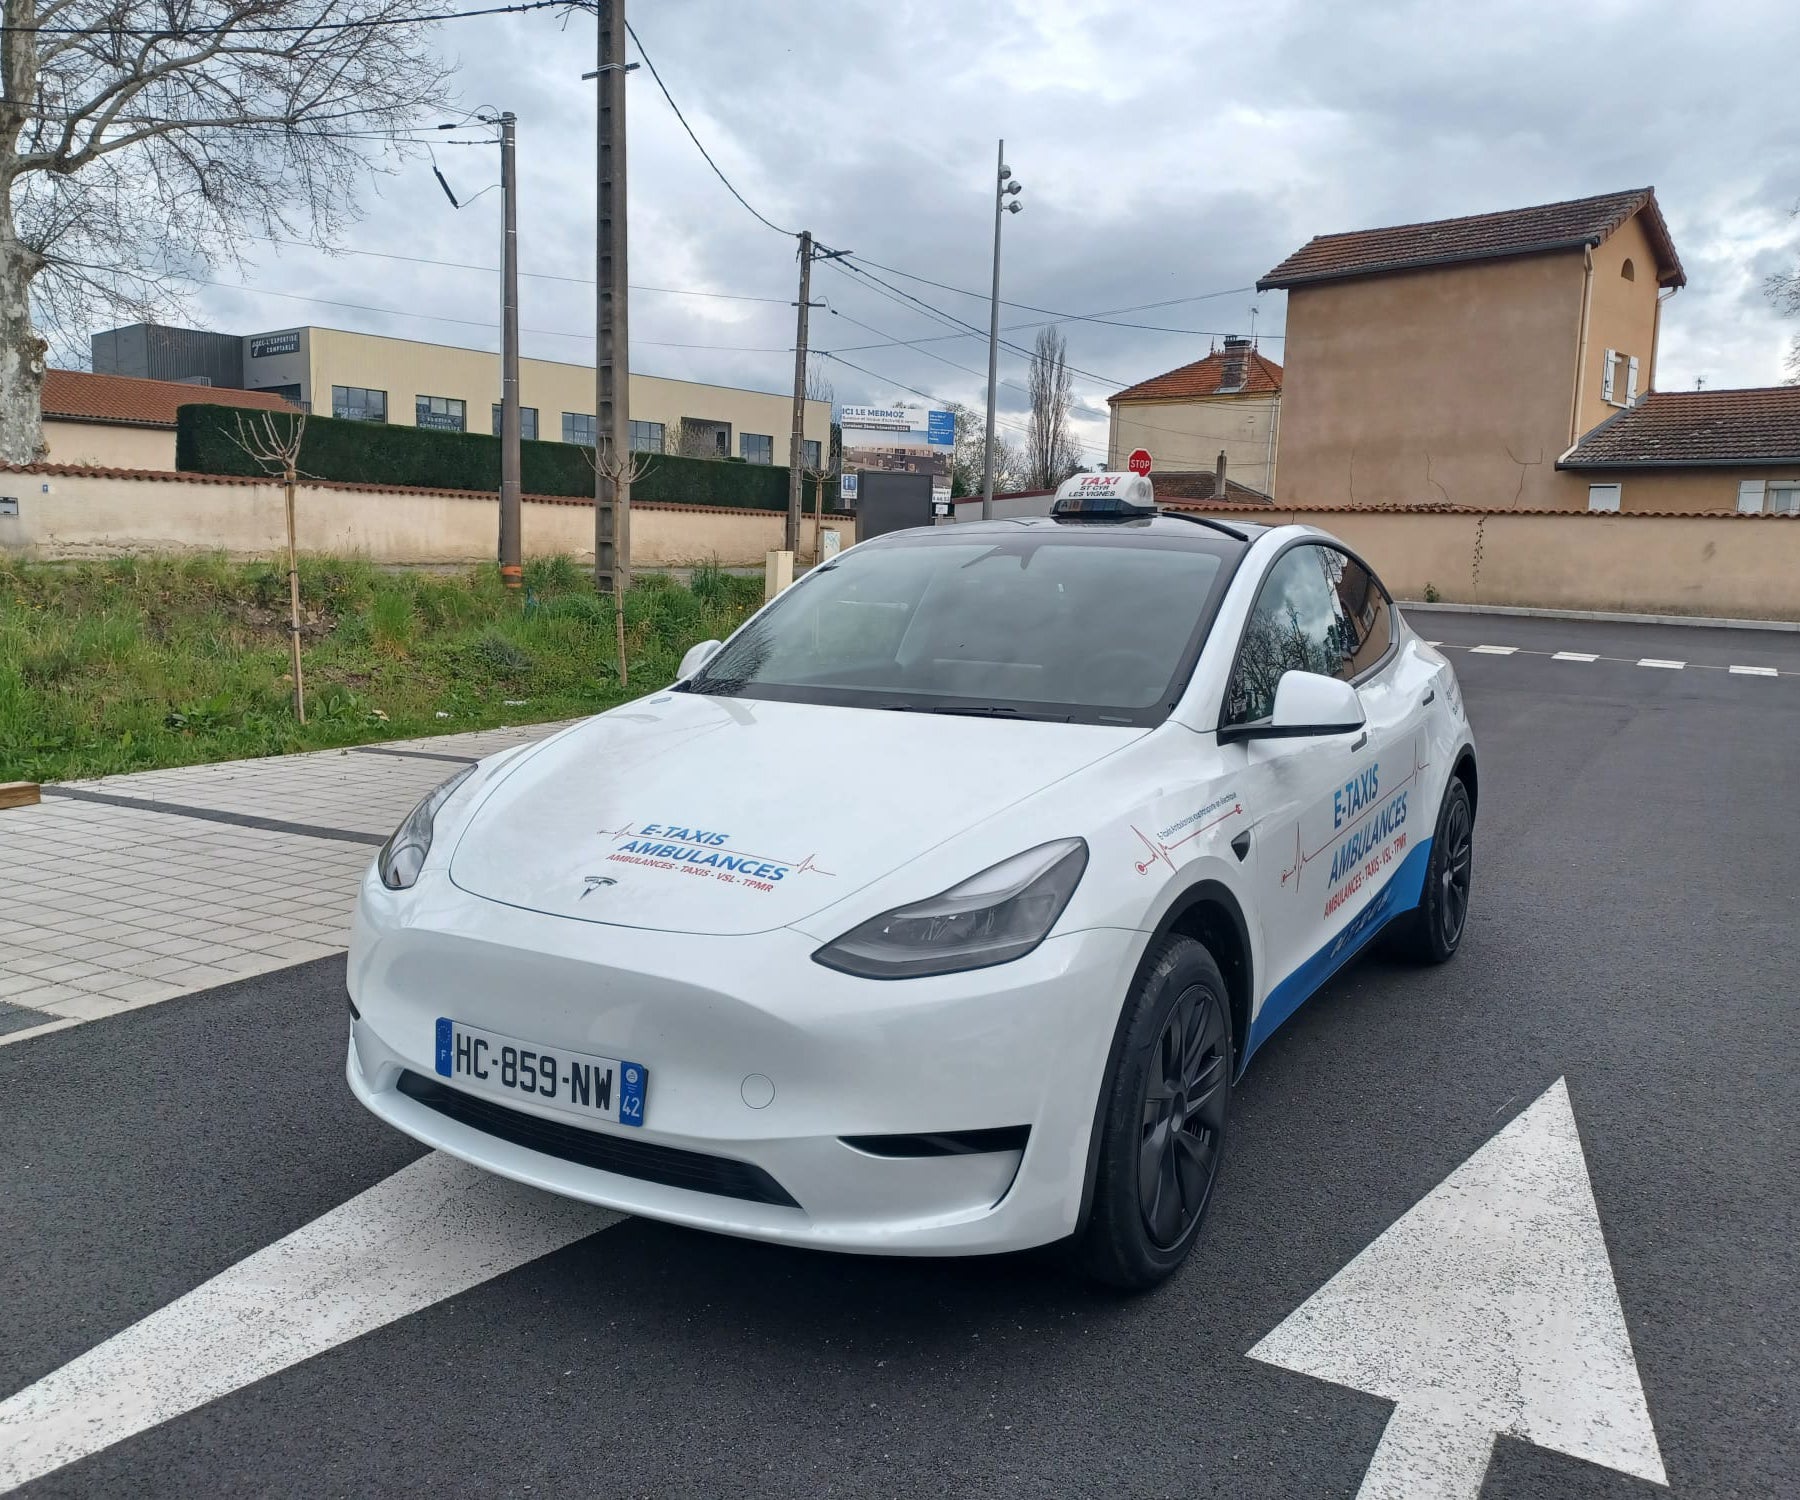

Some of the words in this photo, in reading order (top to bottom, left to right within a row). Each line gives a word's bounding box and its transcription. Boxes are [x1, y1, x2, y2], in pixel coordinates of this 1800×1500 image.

[843, 408, 853, 416] ICI
[856, 408, 866, 416] LE
[868, 409, 905, 418] MERMOZ
[1130, 459, 1150, 469] STOP
[1080, 476, 1121, 486] TAXI
[1333, 762, 1379, 829] E-TAXIS
[639, 824, 730, 846] E-TAXIS
[1328, 791, 1408, 889] AMBULANCES
[605, 854, 675, 870] AMBULANCES
[680, 865, 711, 877] TAXIS
[716, 872, 734, 883] VSL
[742, 878, 774, 893] TPMR
[617, 840, 789, 881] AMBULANCES
[1323, 872, 1362, 920] AMBULANCES
[1365, 856, 1379, 880] TAXIS
[440, 1050, 447, 1061] F
[456, 1033, 613, 1111] HC-859-NW
[622, 1095, 640, 1118] 42
